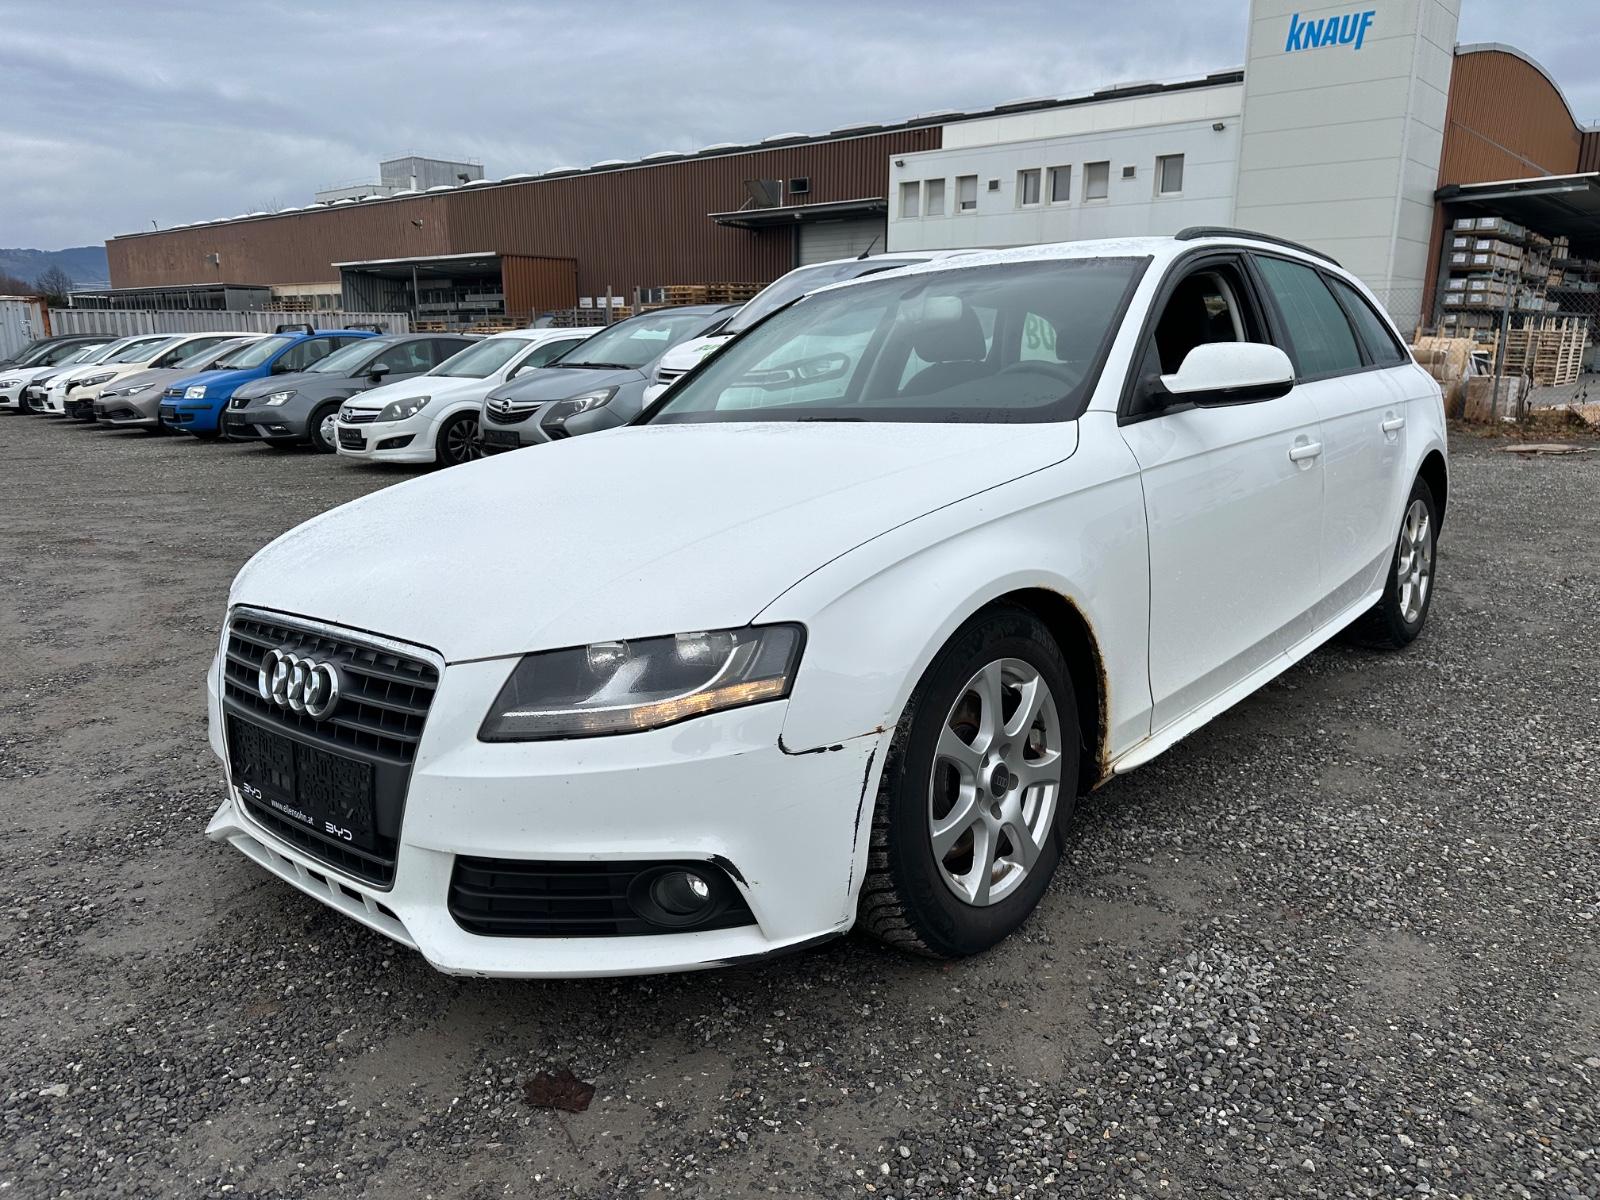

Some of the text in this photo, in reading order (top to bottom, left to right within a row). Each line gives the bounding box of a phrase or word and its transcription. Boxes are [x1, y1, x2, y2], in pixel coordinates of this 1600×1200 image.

[1285, 10, 1376, 52] KNAUF
[243, 782, 262, 800] BYD
[324, 821, 353, 841] BYD
